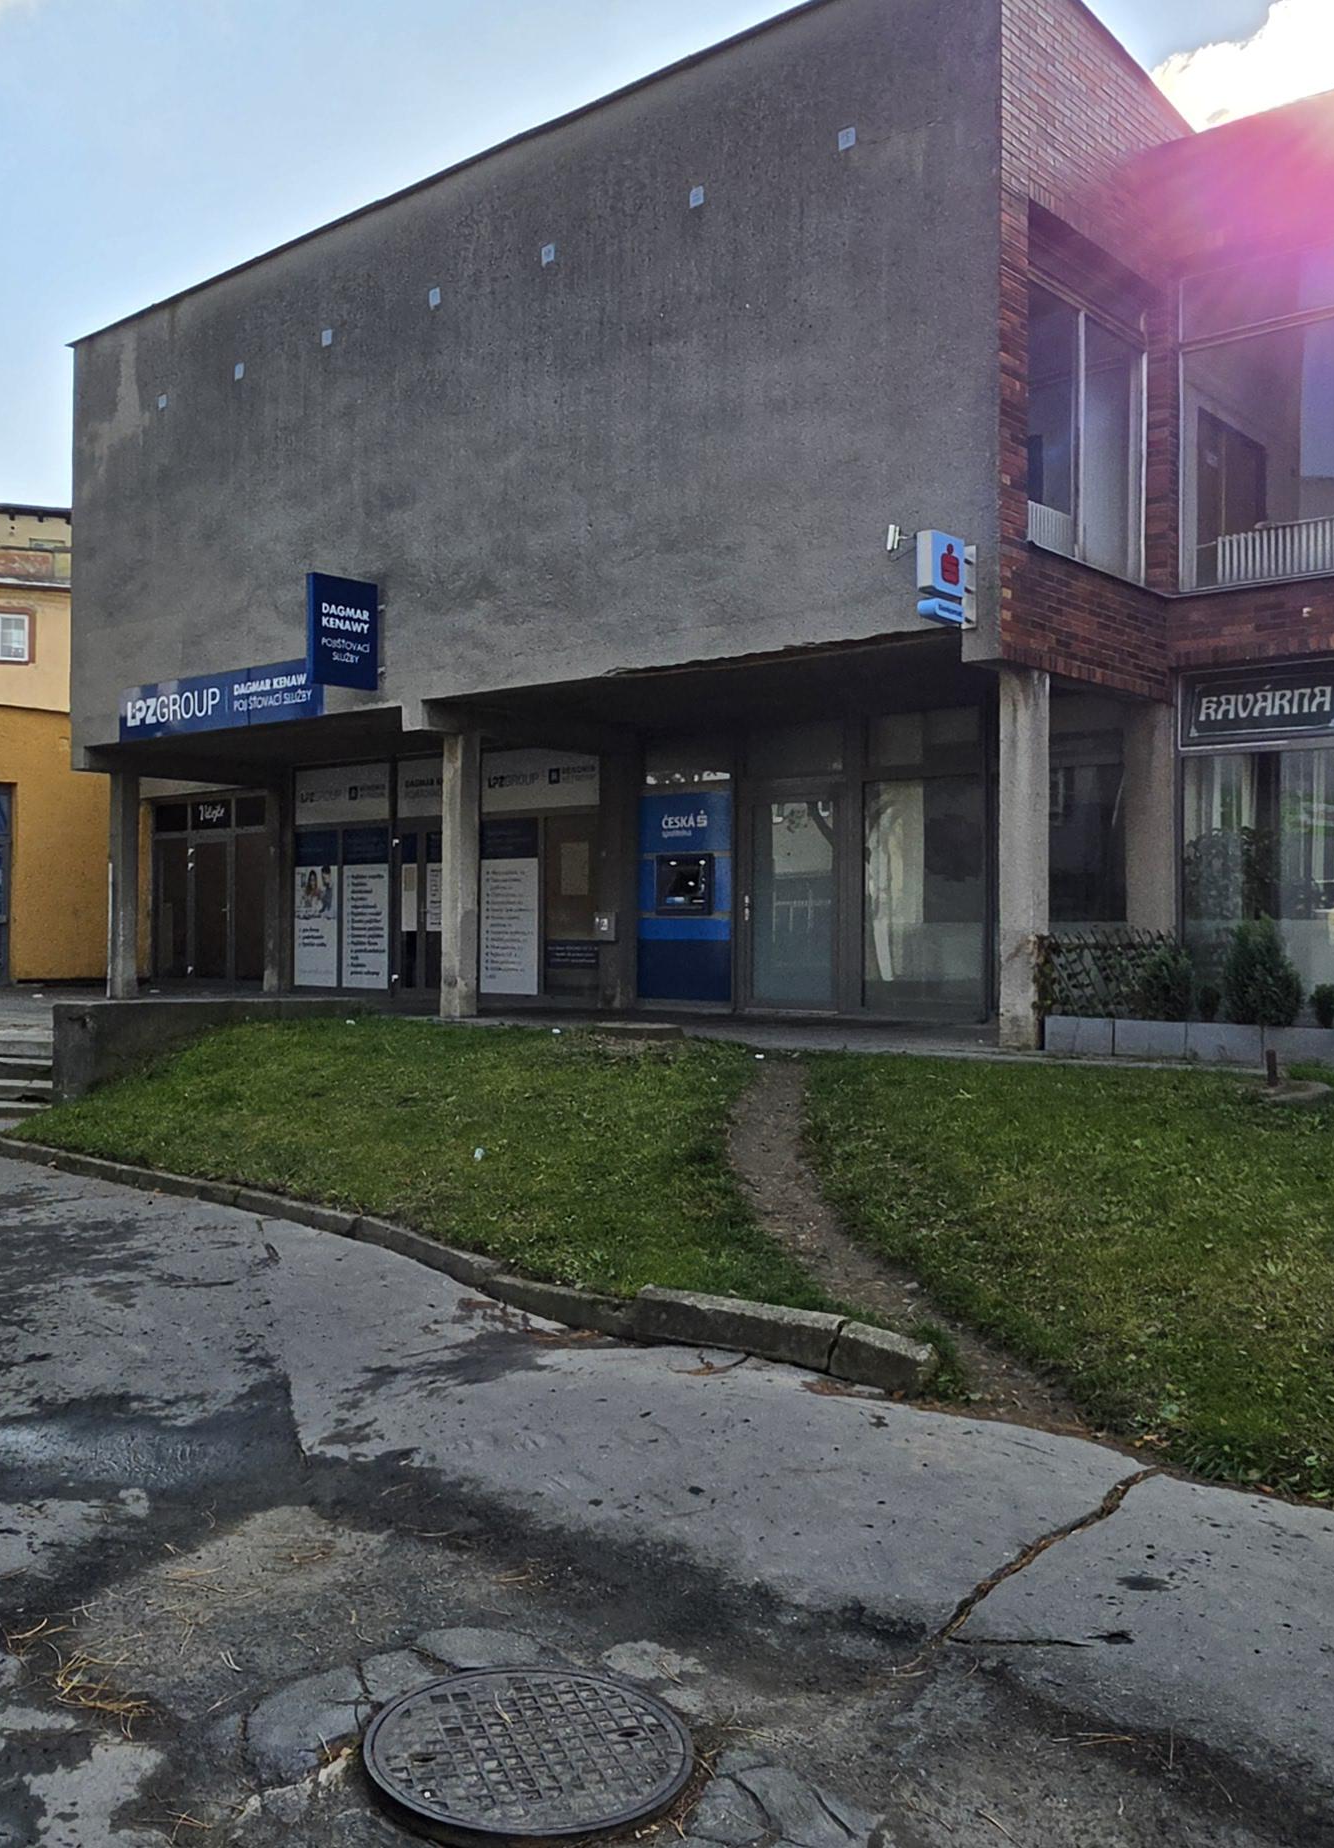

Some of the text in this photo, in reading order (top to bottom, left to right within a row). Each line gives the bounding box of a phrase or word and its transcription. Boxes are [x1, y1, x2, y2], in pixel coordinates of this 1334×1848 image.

[322, 602, 370, 621] DAGMAR
[322, 616, 370, 634] KENAWY
[233, 679, 270, 696] DAGMAR
[272, 673, 308, 690] KENAW
[1199, 684, 1332, 721] KAVÁRNA
[661, 813, 696, 829] ČESKÁ
